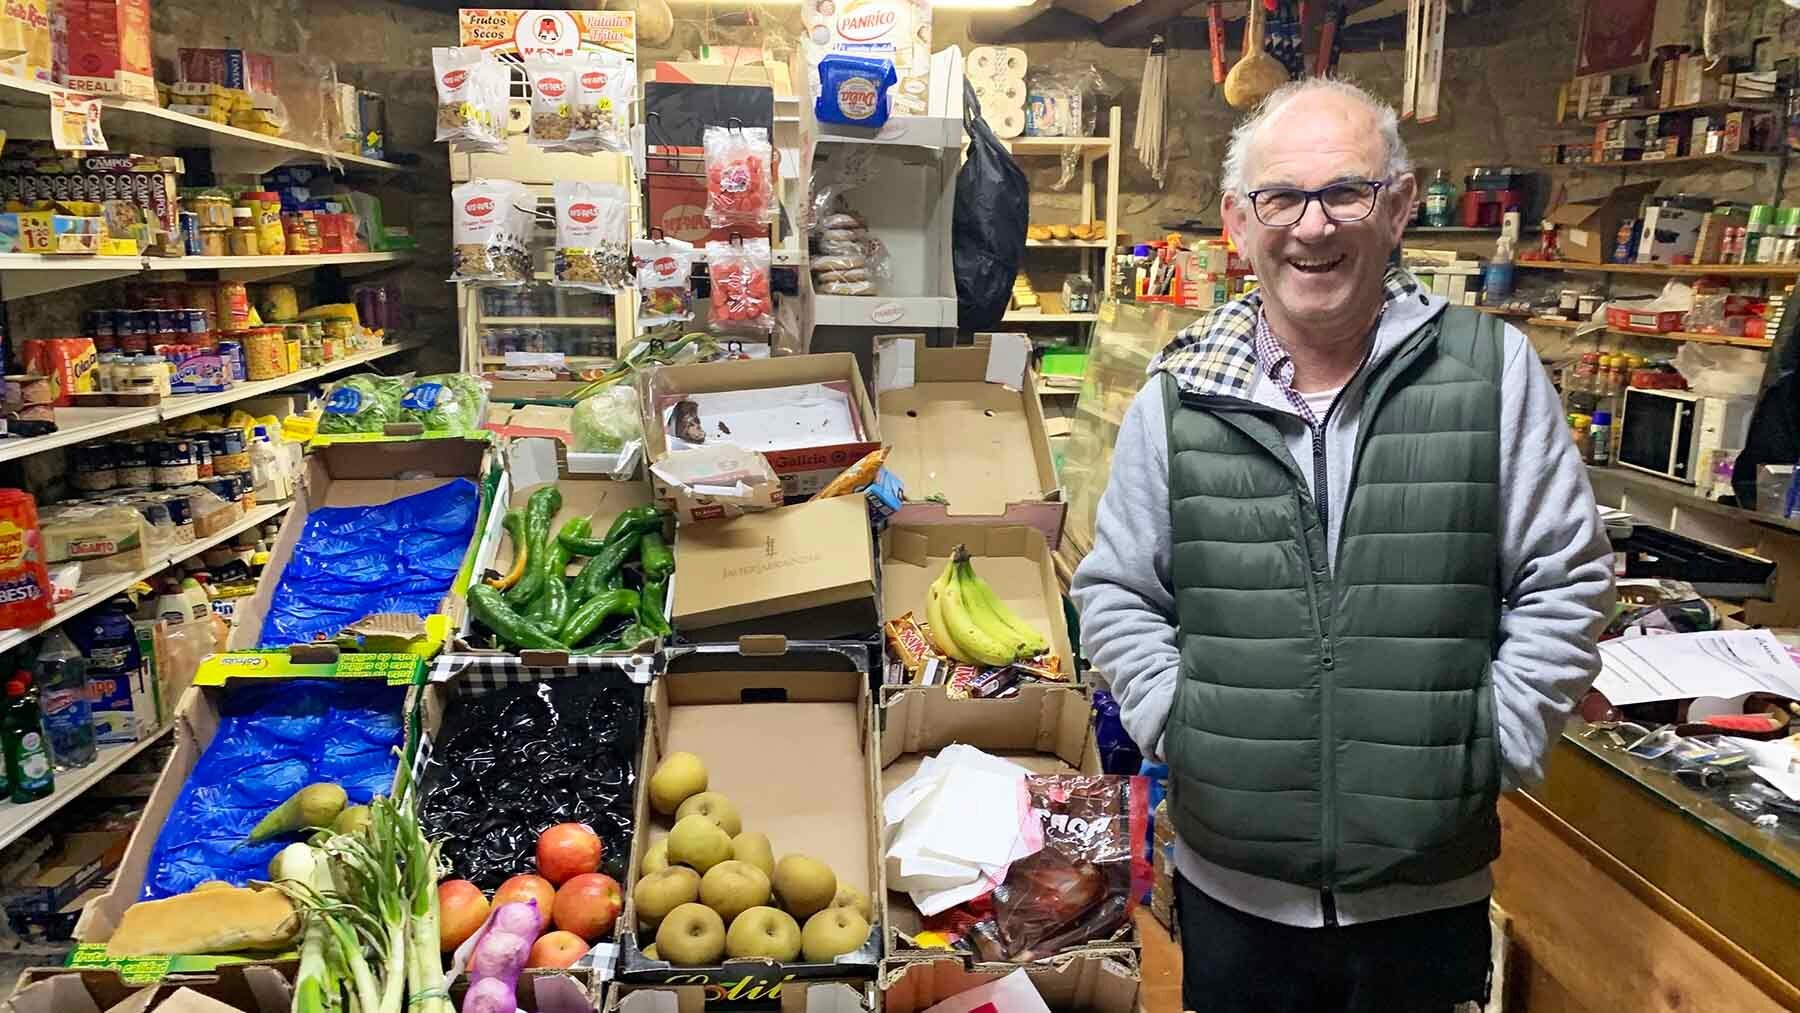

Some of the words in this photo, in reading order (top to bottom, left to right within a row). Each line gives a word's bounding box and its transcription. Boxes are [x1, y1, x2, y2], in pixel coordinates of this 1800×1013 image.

[469, 15, 507, 26] Frutos
[842, 10, 895, 31] PANRICO
[473, 28, 505, 39] Secos
[86, 157, 133, 170] CAMPOS
[151, 173, 166, 217] CAMPOS
[0, 584, 34, 603] BEST
